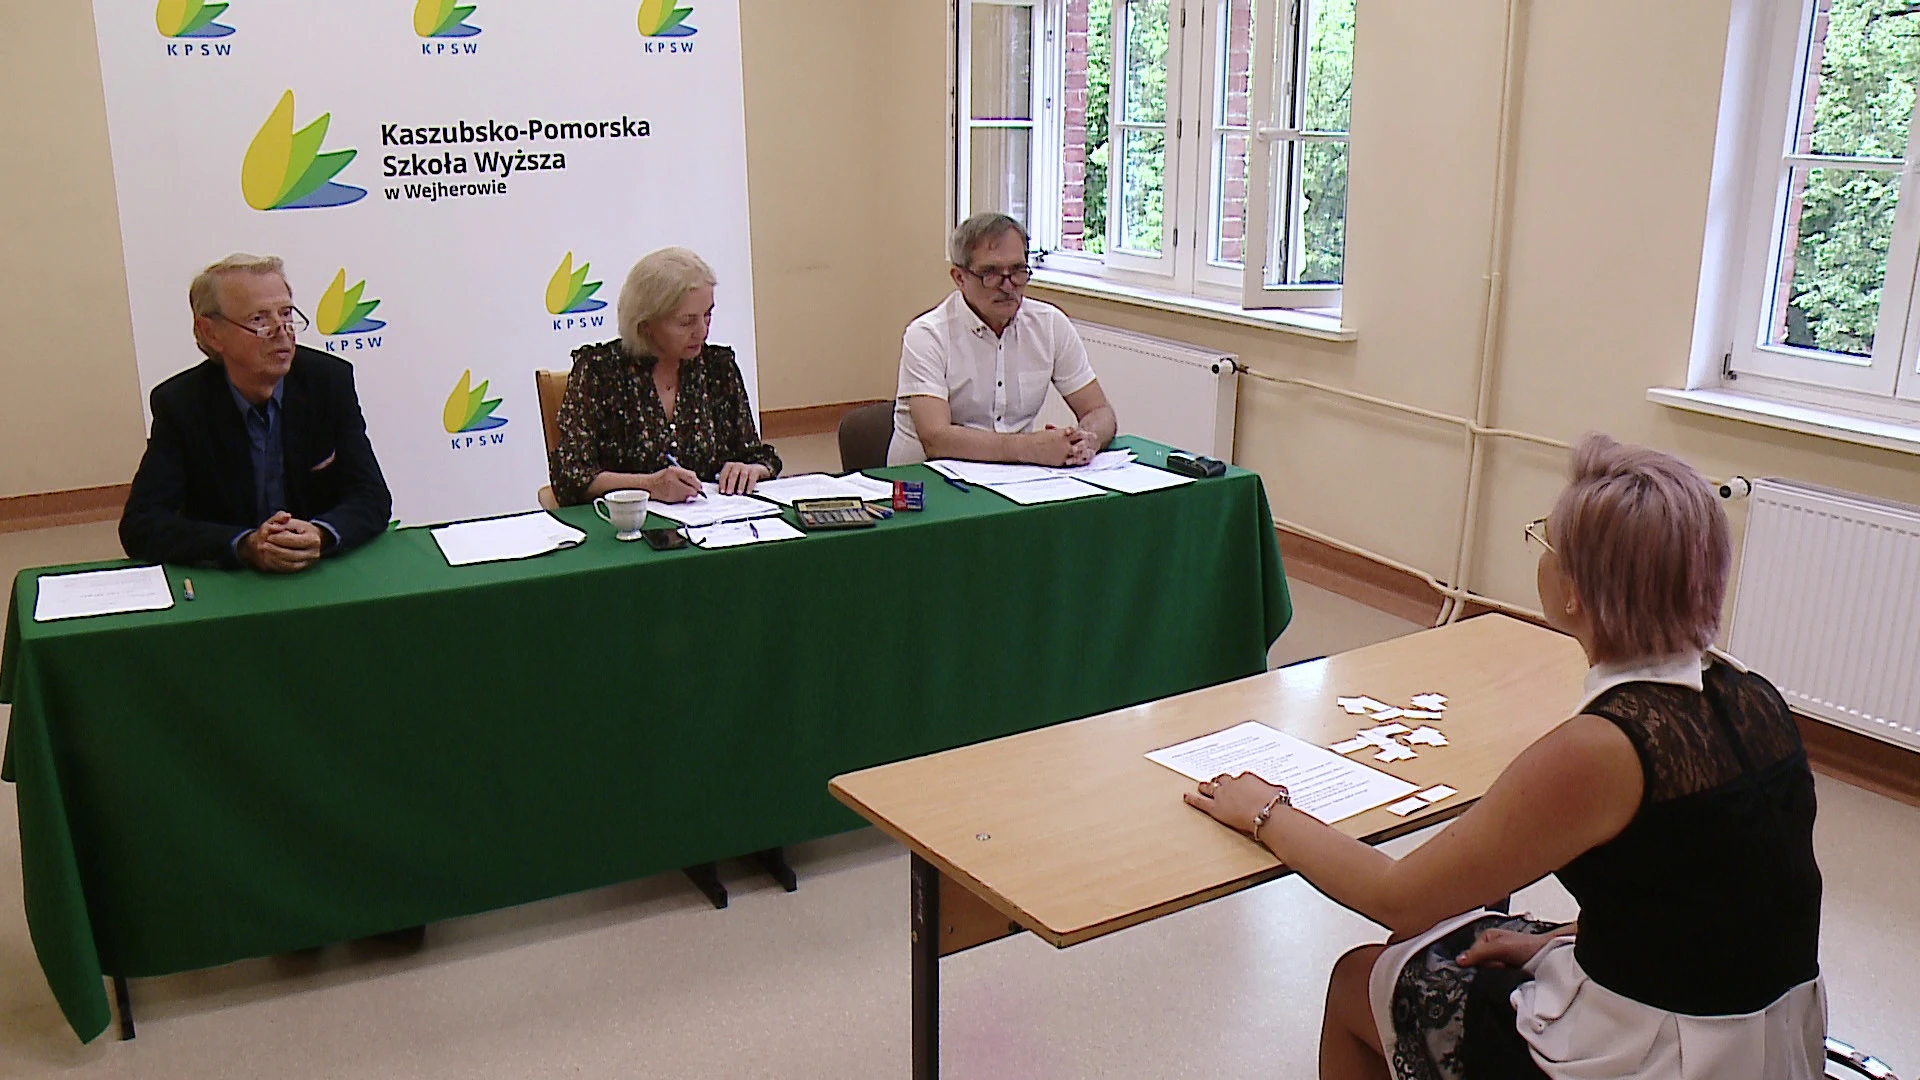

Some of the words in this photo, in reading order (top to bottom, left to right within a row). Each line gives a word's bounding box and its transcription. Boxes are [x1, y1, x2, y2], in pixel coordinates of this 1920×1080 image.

[167, 43, 231, 56] KPSW
[422, 43, 478, 55] KPSW
[644, 41, 694, 54] KPSW
[381, 115, 651, 146] Kaszubsko-Pomorska
[383, 151, 468, 177] Szkoła
[474, 149, 567, 178] Wyższa
[384, 187, 400, 200] w
[404, 181, 507, 202] Wejherowie
[553, 315, 604, 331] KPSW
[325, 336, 382, 352] KPSW
[451, 433, 505, 449] KPSW
